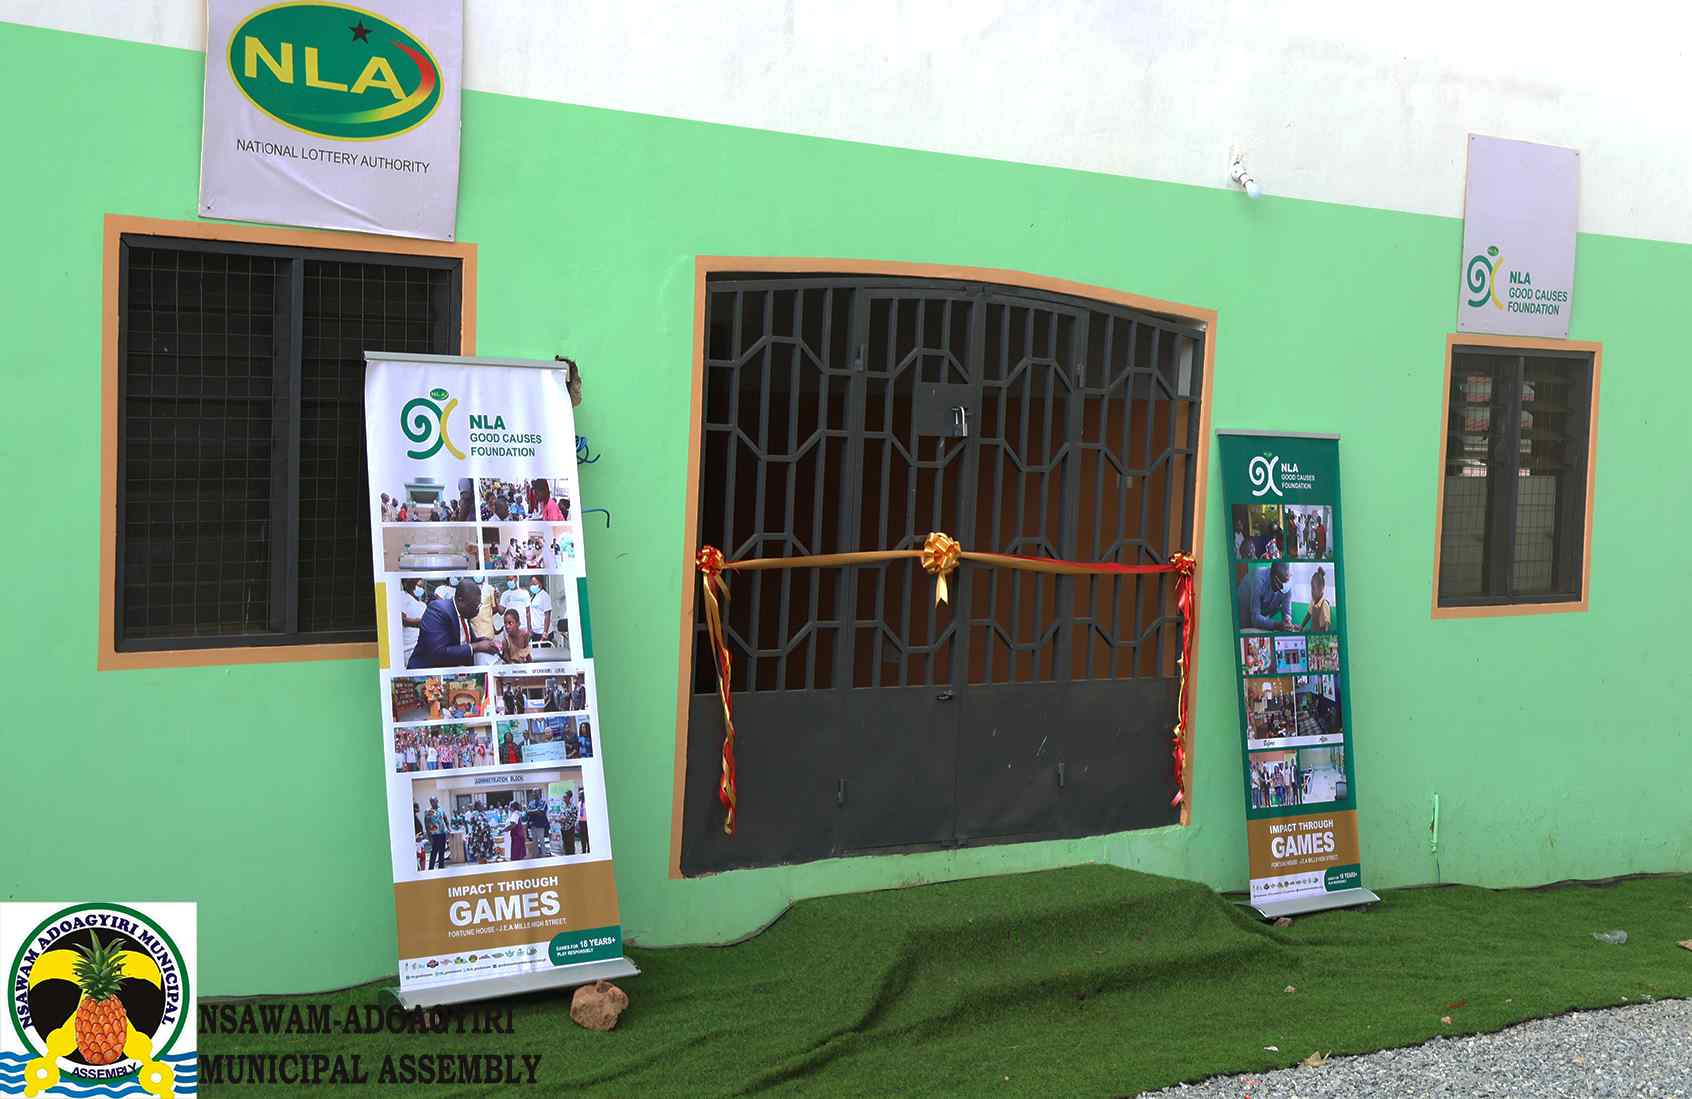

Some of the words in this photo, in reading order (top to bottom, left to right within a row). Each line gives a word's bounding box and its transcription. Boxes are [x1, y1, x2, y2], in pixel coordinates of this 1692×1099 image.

[245, 35, 409, 100] NLA
[236, 139, 298, 159] NATIONAL
[301, 148, 359, 166] LOTTERY
[360, 151, 431, 173] AUTHORITY
[1509, 271, 1531, 284] NLA
[1508, 288, 1533, 300] GOOD
[1534, 289, 1568, 302] CAUSES
[1508, 302, 1560, 315] FOUNDATION
[469, 414, 506, 430] NLA
[470, 432, 500, 444] GOOD
[503, 433, 542, 444] CAUSES
[470, 446, 536, 458] FOUNDATION
[1280, 464, 1298, 472] NLA
[1270, 824, 1296, 834] IMPACT
[1299, 820, 1334, 831] THROUGH
[1272, 832, 1335, 860] GAMES
[448, 883, 494, 898] IMPACT
[497, 876, 559, 892] THROUGH
[449, 890, 560, 926] GAMES
[448, 928, 475, 938] FORTUNE
[589, 936, 616, 946] YEARS+
